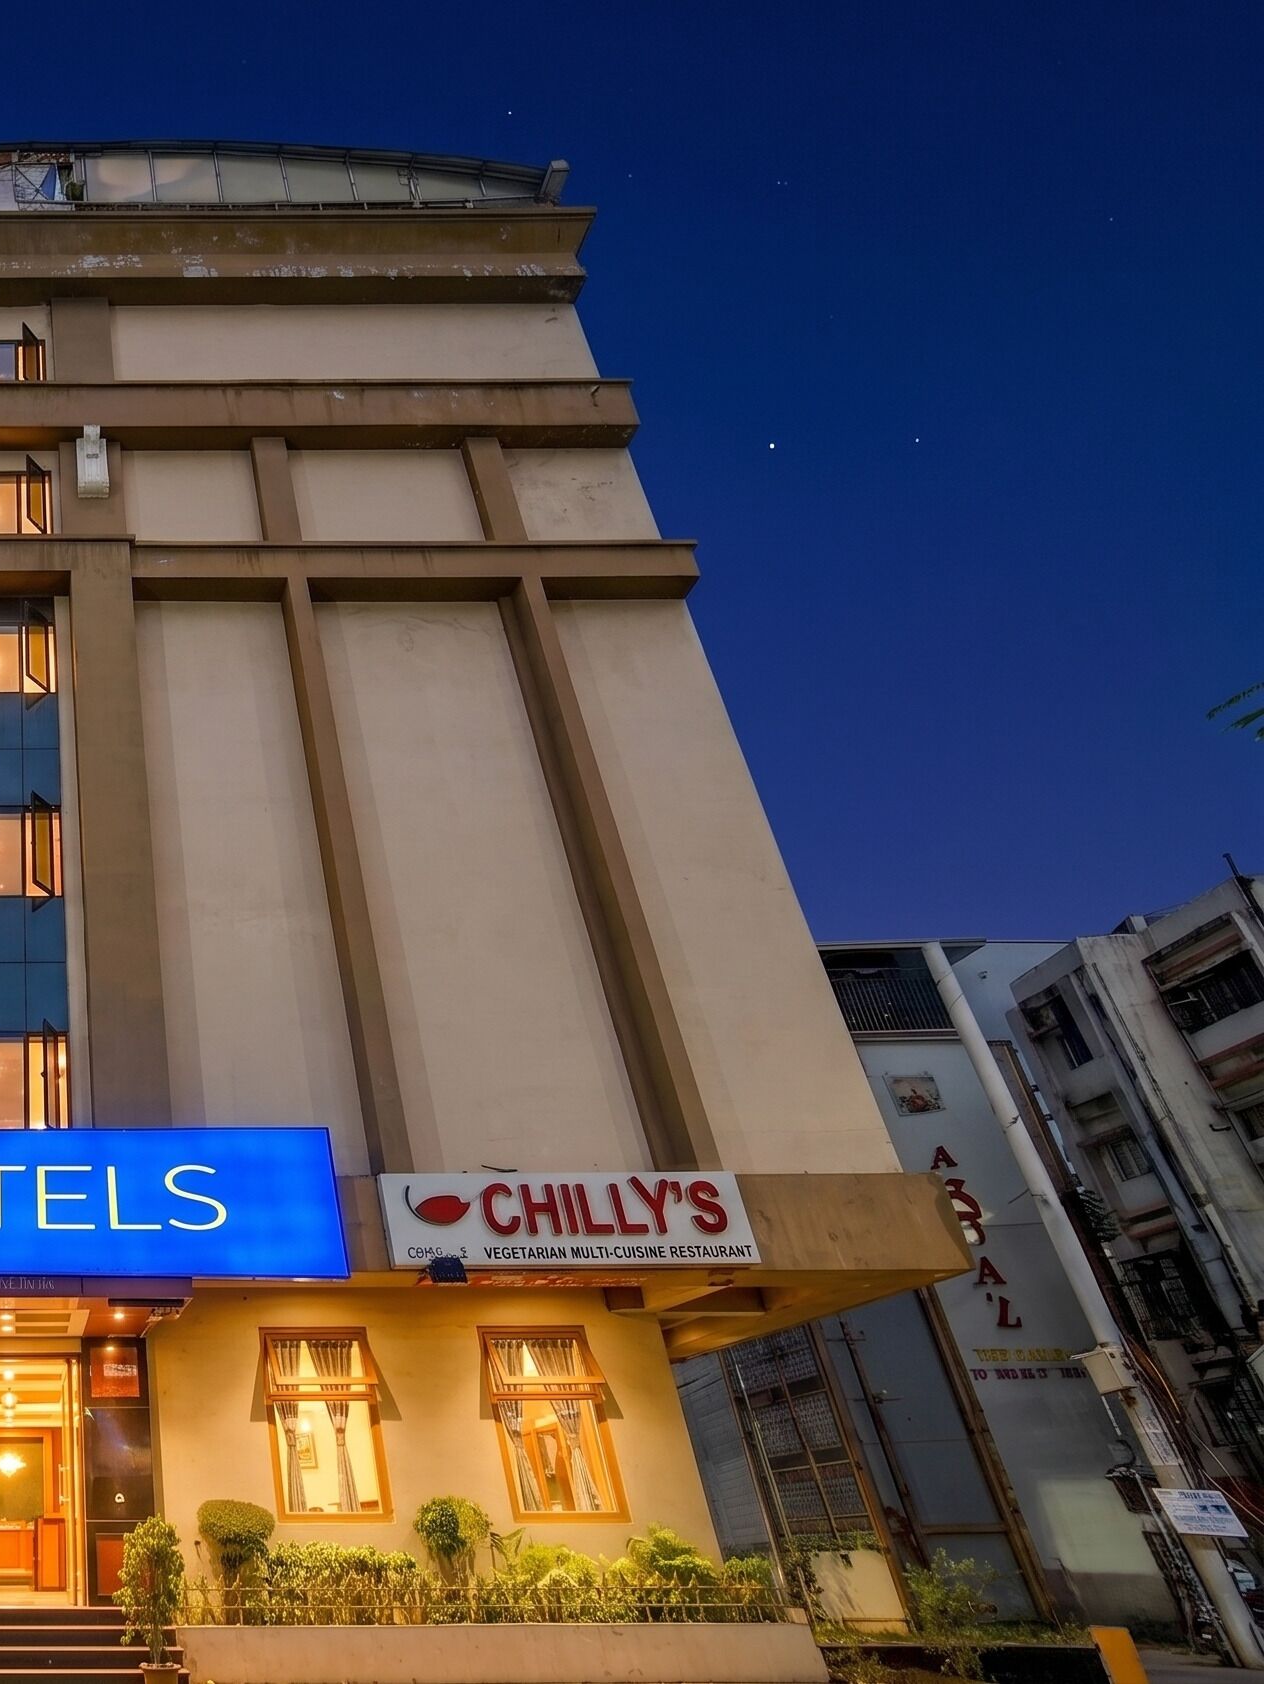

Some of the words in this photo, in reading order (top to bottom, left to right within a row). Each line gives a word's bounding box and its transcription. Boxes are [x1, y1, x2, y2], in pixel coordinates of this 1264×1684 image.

[480, 1176, 728, 1237] CHILLY'S
[484, 1246, 567, 1260] VEGETARIAN
[570, 1246, 668, 1260] MULTI-CUISINE
[670, 1245, 752, 1259] RESTAURANT
